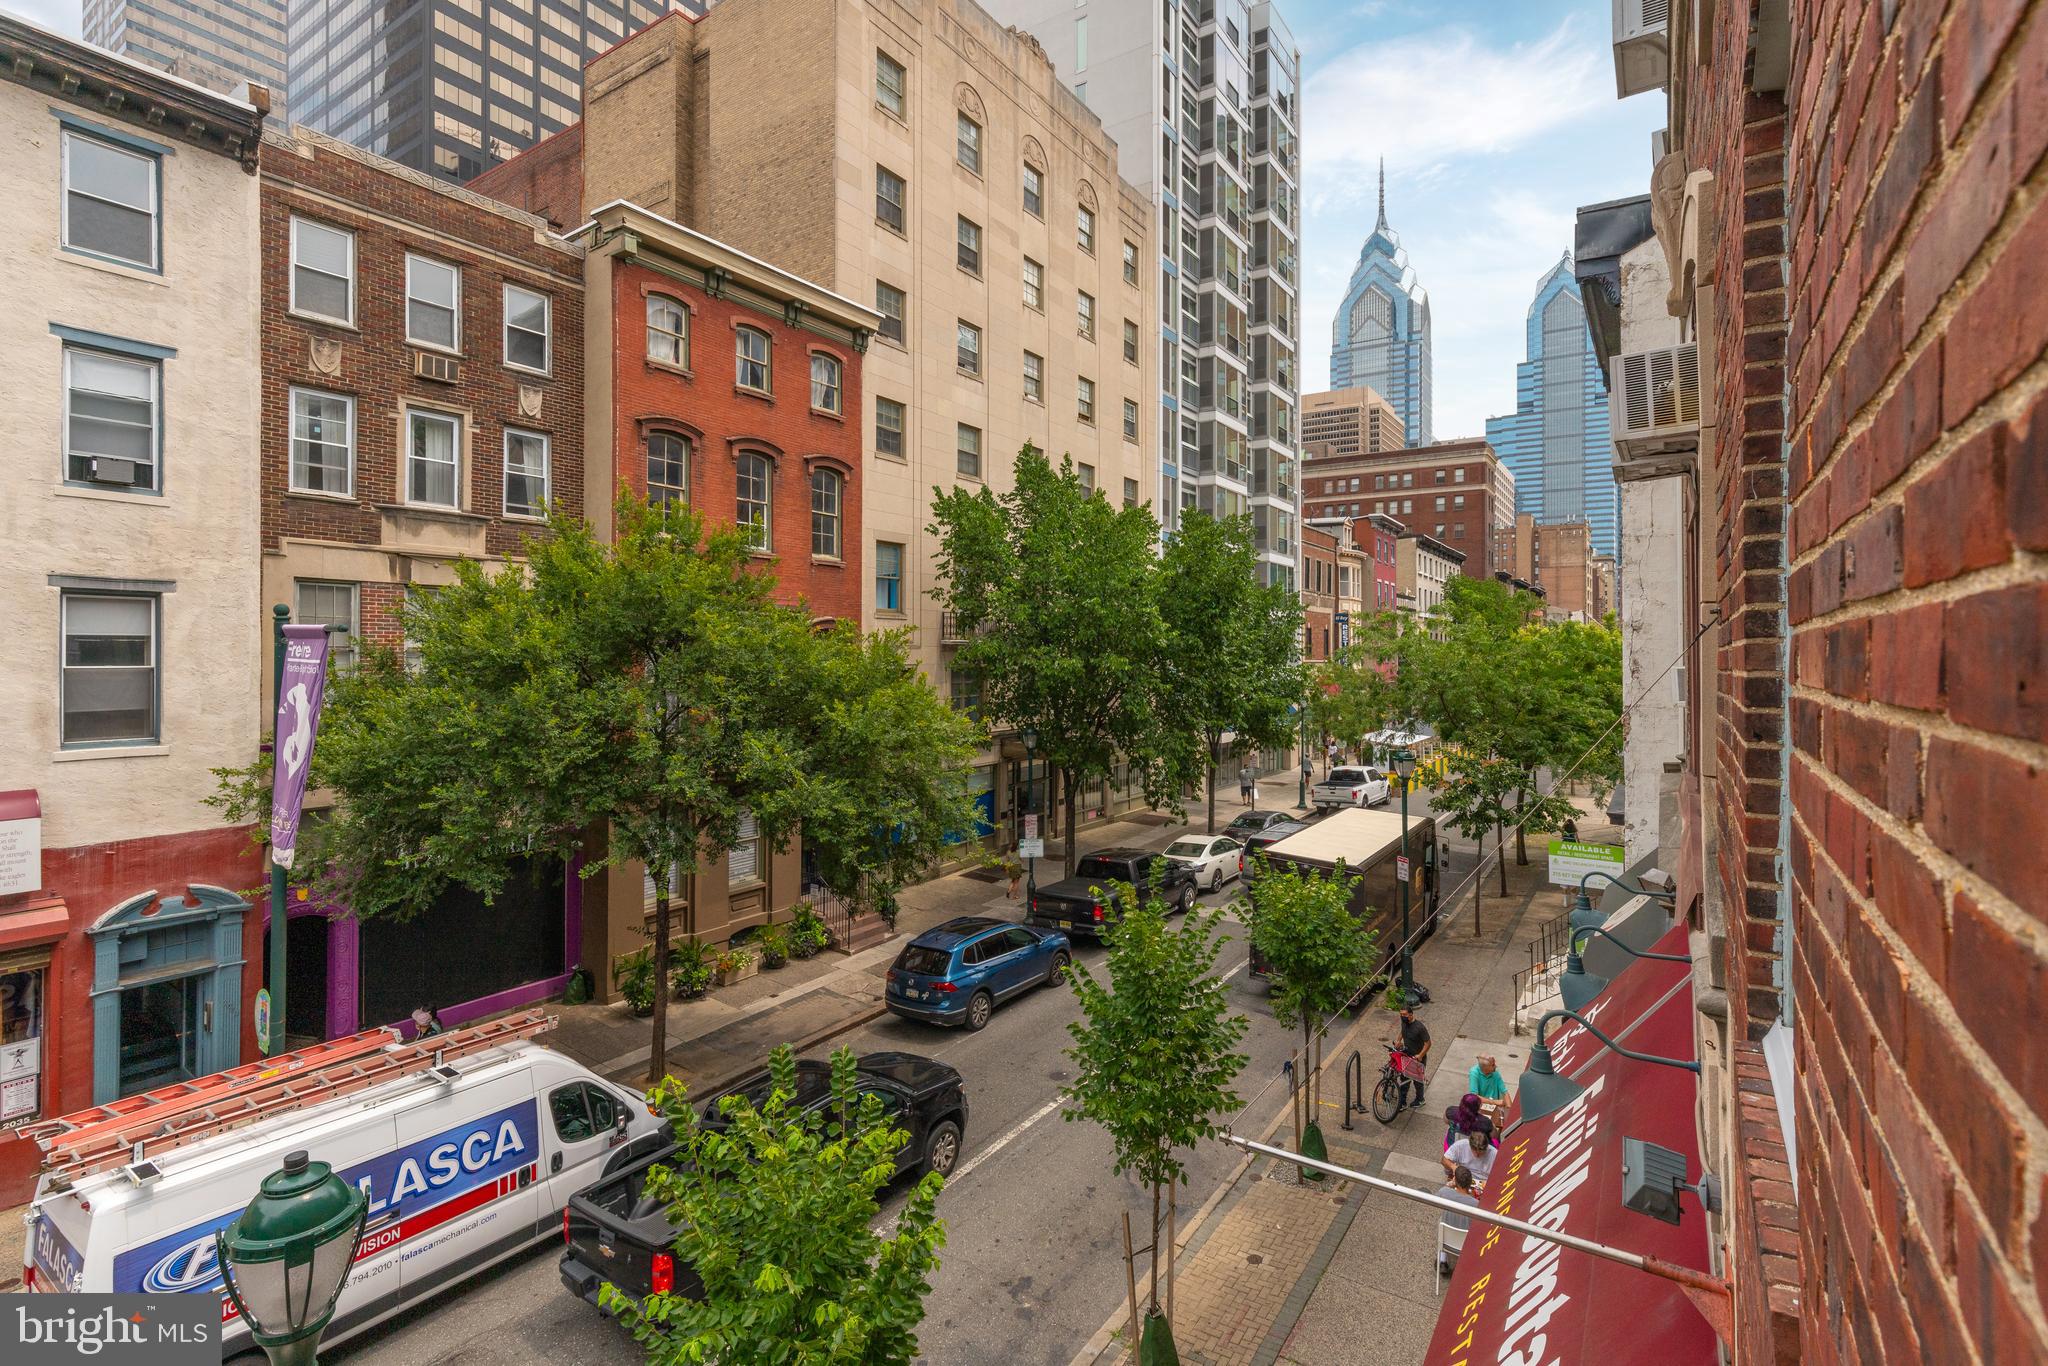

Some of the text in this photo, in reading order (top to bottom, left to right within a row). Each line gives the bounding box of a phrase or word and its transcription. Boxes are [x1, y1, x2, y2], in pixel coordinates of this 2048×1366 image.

[1560, 843, 1612, 855] AVAILABLE
[3, 1116, 31, 1130] 2035
[401, 1212, 498, 1262] falascamechanical.com
[38, 1222, 80, 1293] FALASC
